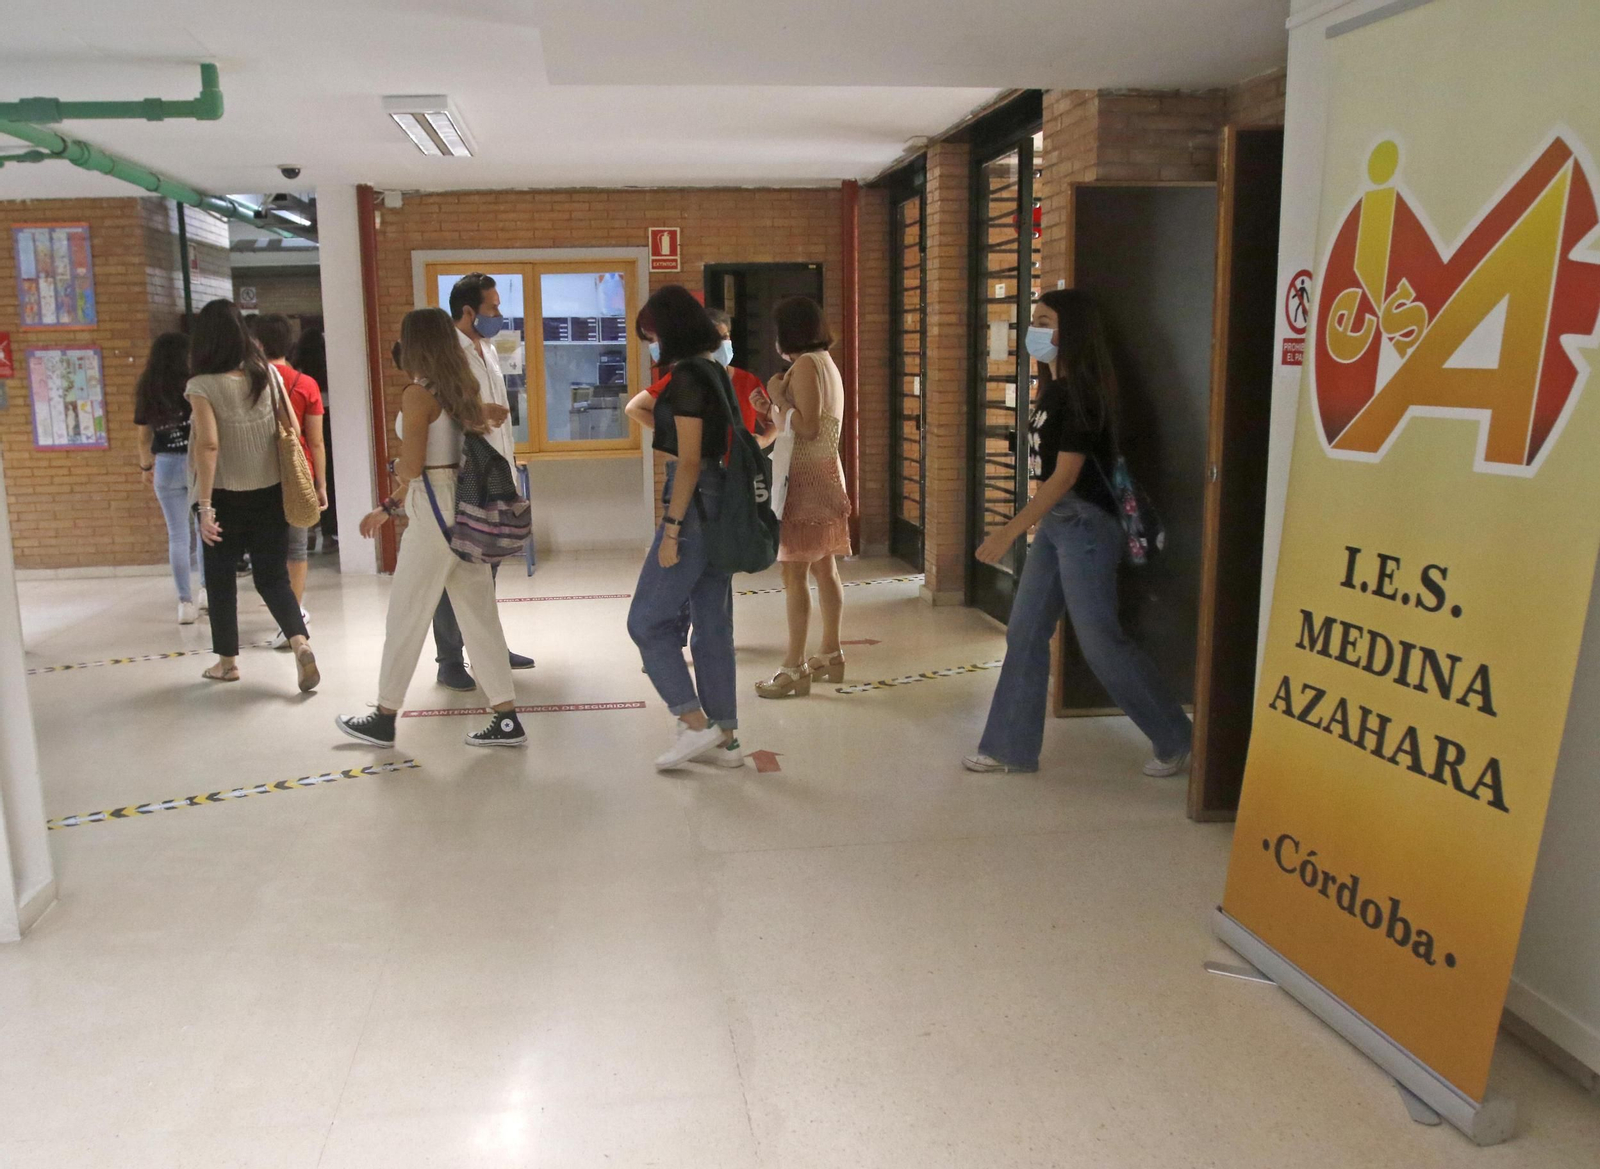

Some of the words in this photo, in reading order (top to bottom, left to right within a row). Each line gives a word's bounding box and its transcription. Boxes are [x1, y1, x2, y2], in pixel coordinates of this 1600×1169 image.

[1283, 342, 1305, 351] PROHIB
[1340, 545, 1463, 618] I.E.S.
[1295, 608, 1497, 718] MEDINA
[421, 708, 484, 716] MANTENGA
[515, 705, 559, 713] STANCIA
[1268, 674, 1510, 814] AZAHARA
